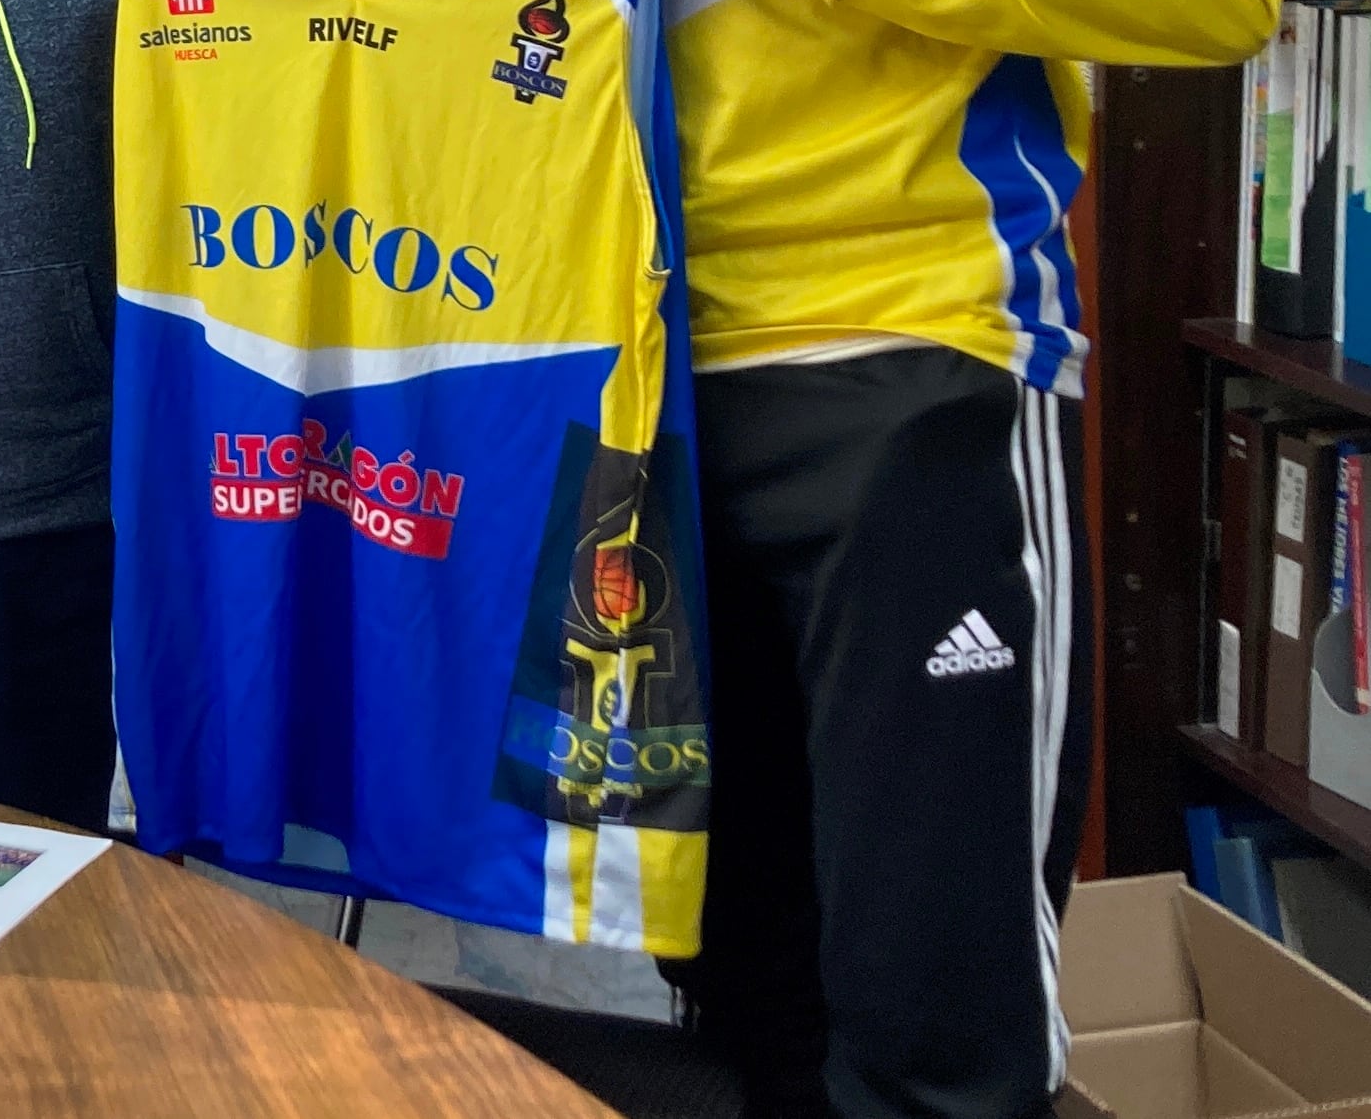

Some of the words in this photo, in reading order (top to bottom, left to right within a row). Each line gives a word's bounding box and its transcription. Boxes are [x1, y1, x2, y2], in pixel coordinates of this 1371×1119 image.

[139, 22, 252, 49] salesianos
[308, 17, 399, 52] RIVELF
[174, 48, 218, 61] HUESCA
[180, 199, 499, 311] BOSCOS
[209, 417, 465, 517] LTORAGÓN
[926, 647, 1015, 677] adidas
